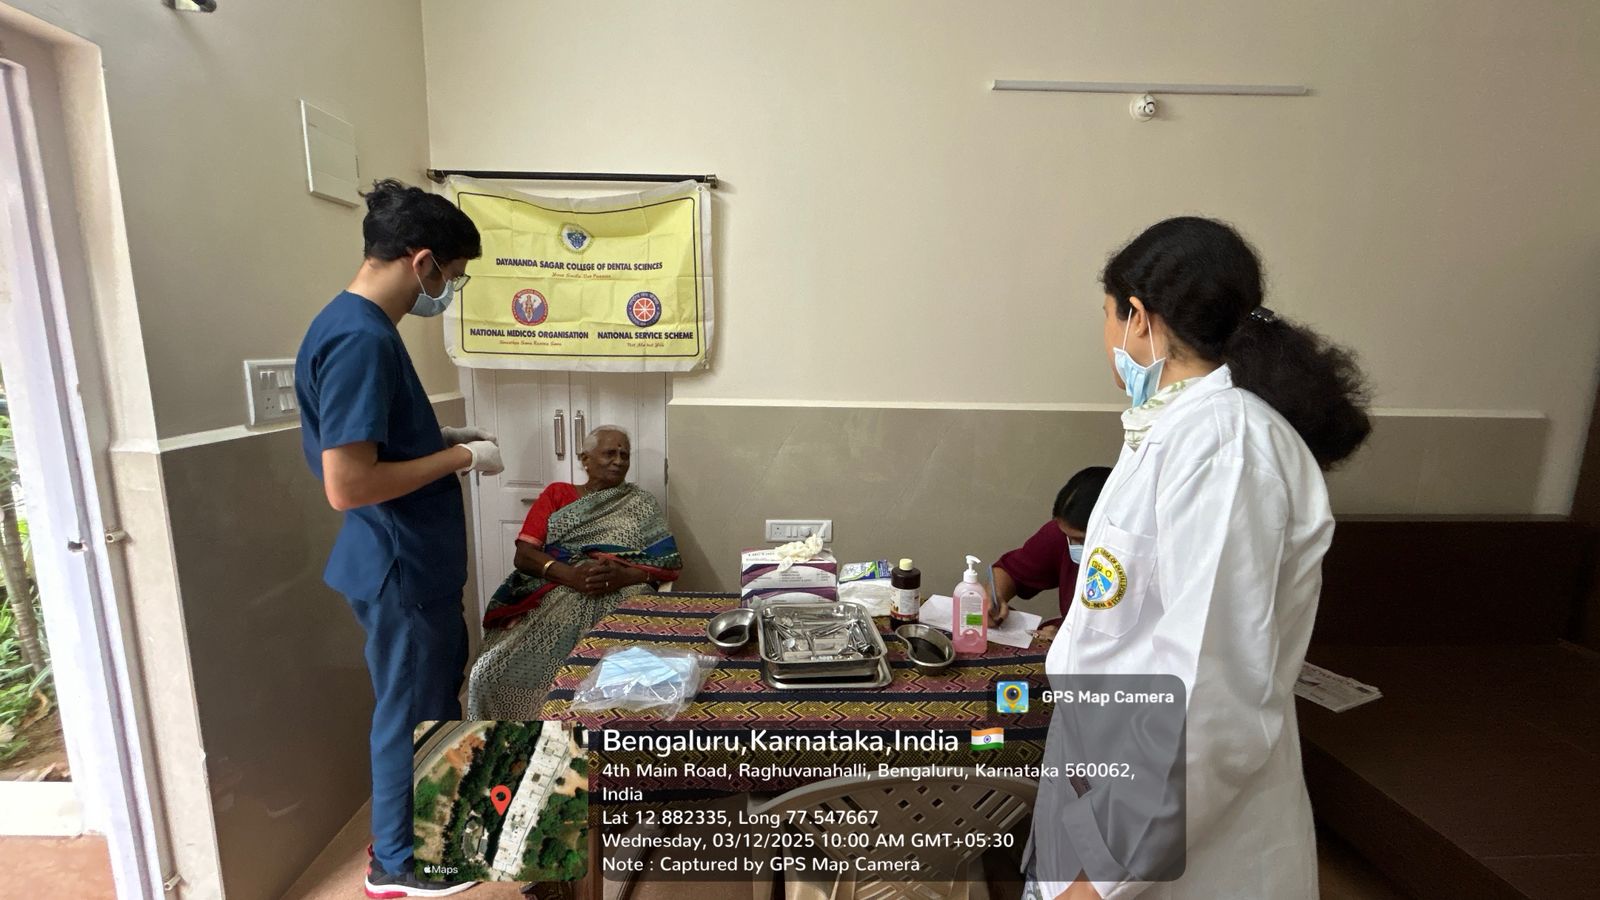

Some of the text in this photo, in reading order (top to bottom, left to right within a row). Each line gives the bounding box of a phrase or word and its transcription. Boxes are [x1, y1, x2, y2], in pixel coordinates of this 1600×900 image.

[496, 258, 663, 271] DAYANANDA SAGAR COLLEGE OF DENTAL SCIENCES
[537, 331, 589, 339] ORGANISATION
